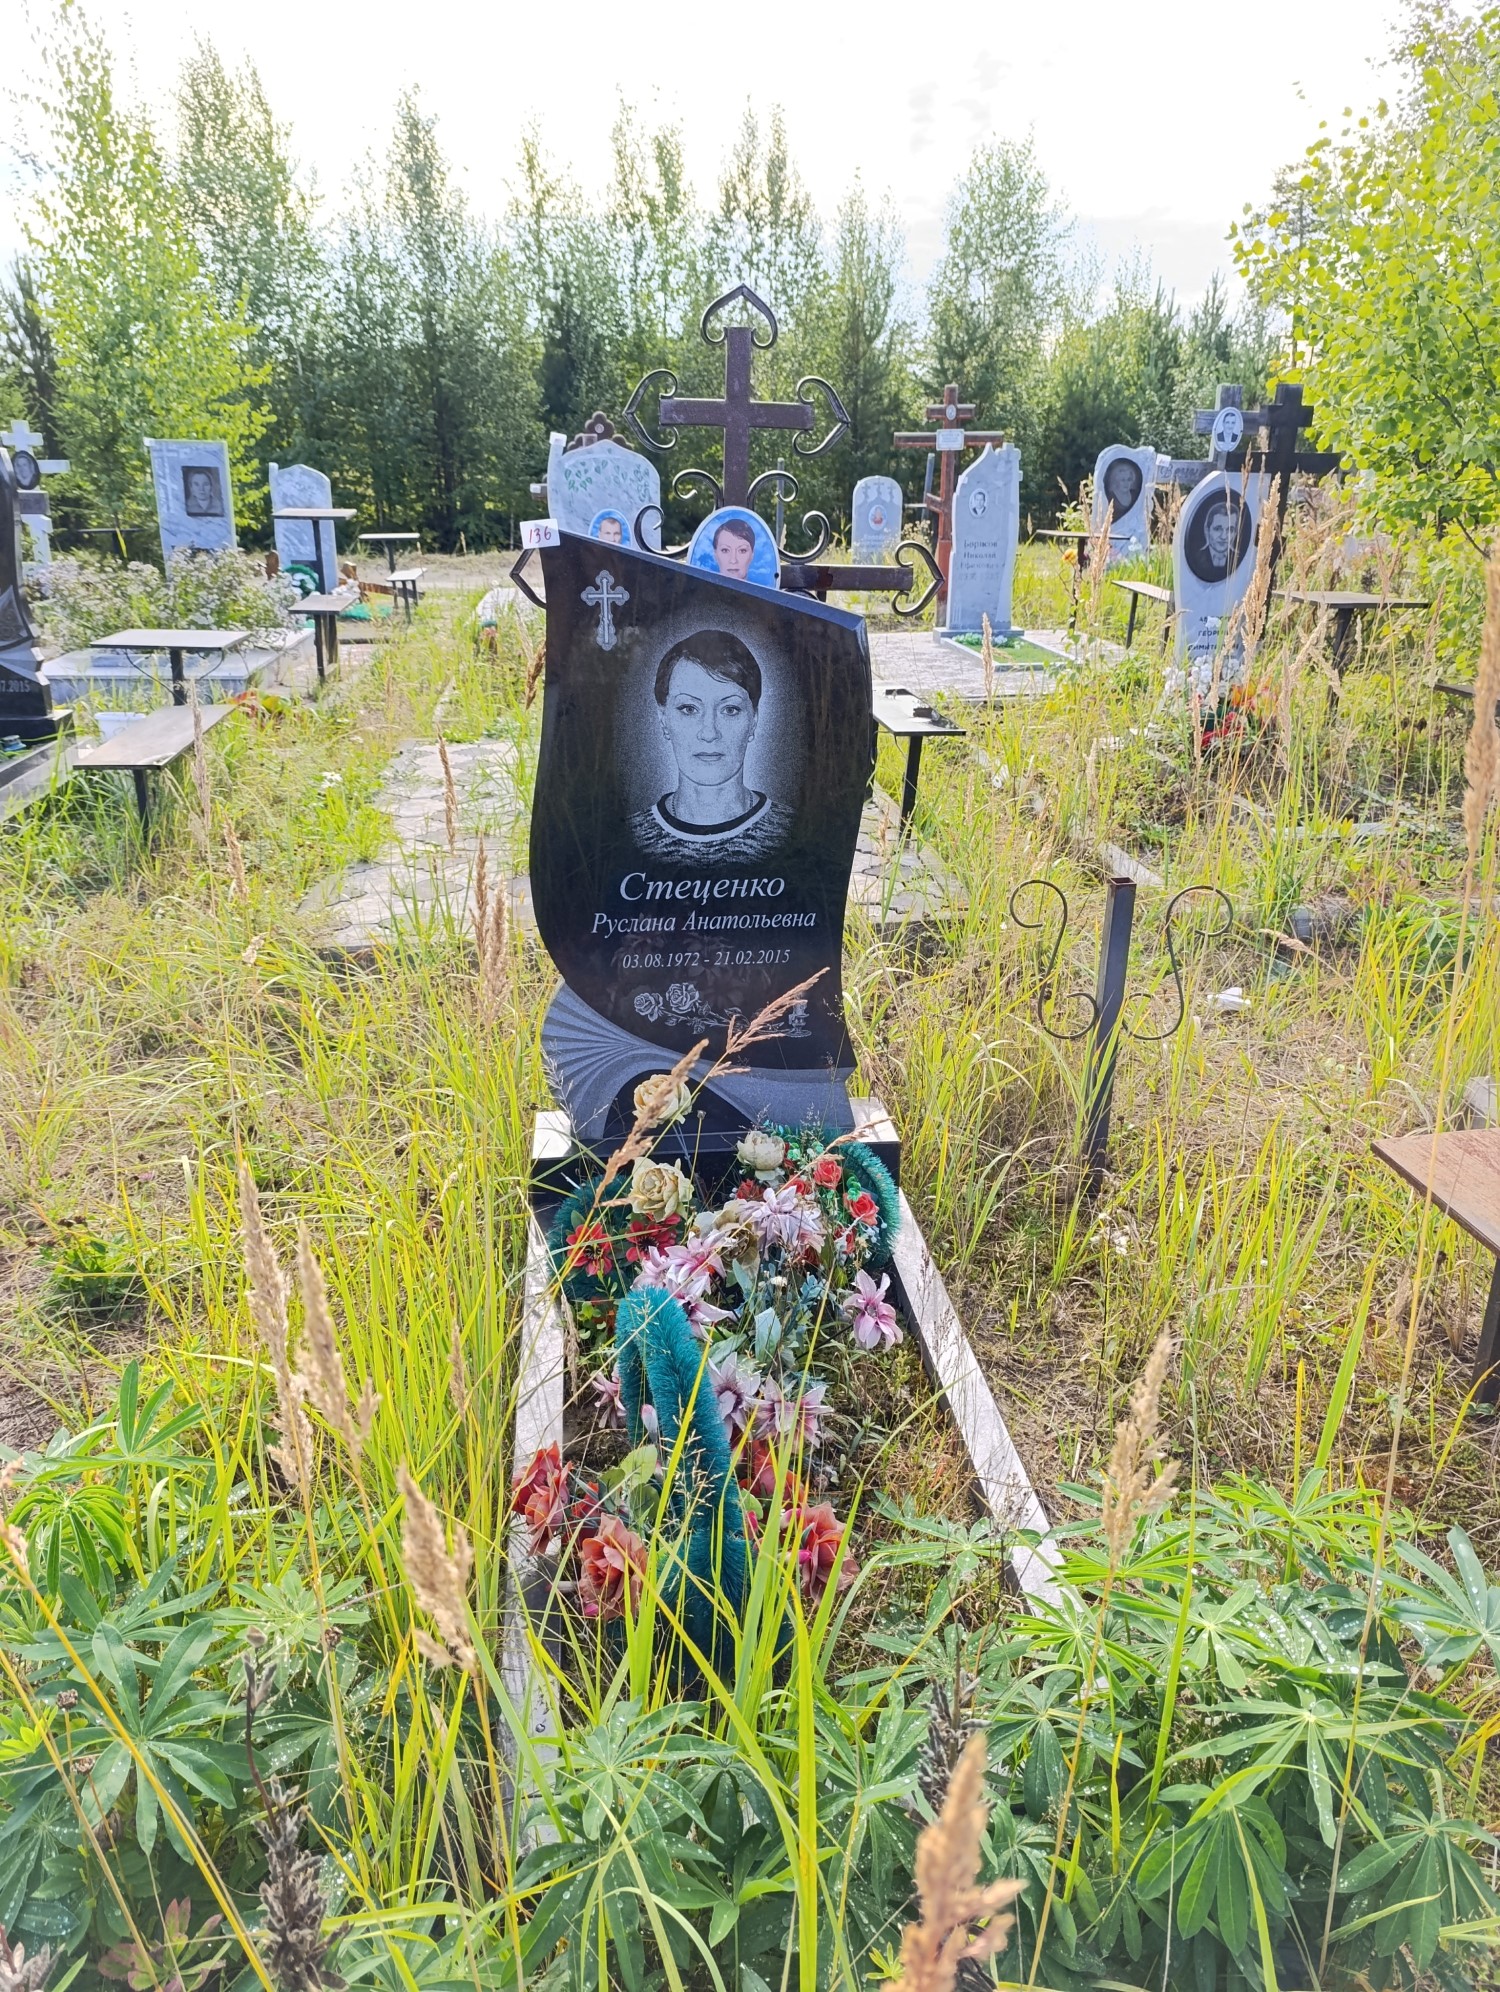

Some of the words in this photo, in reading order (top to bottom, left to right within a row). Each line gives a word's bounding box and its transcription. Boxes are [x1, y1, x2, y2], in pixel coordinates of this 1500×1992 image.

[529, 525, 552, 543] 136
[0, 680, 31, 692] 7.2015
[619, 872, 786, 905] Стеценко
[590, 912, 677, 938] Руслана
[681, 910, 817, 931] Анатольевна
[622, 952, 700, 969] 03.08.1972
[714, 949, 791, 966] 21.02.2015
